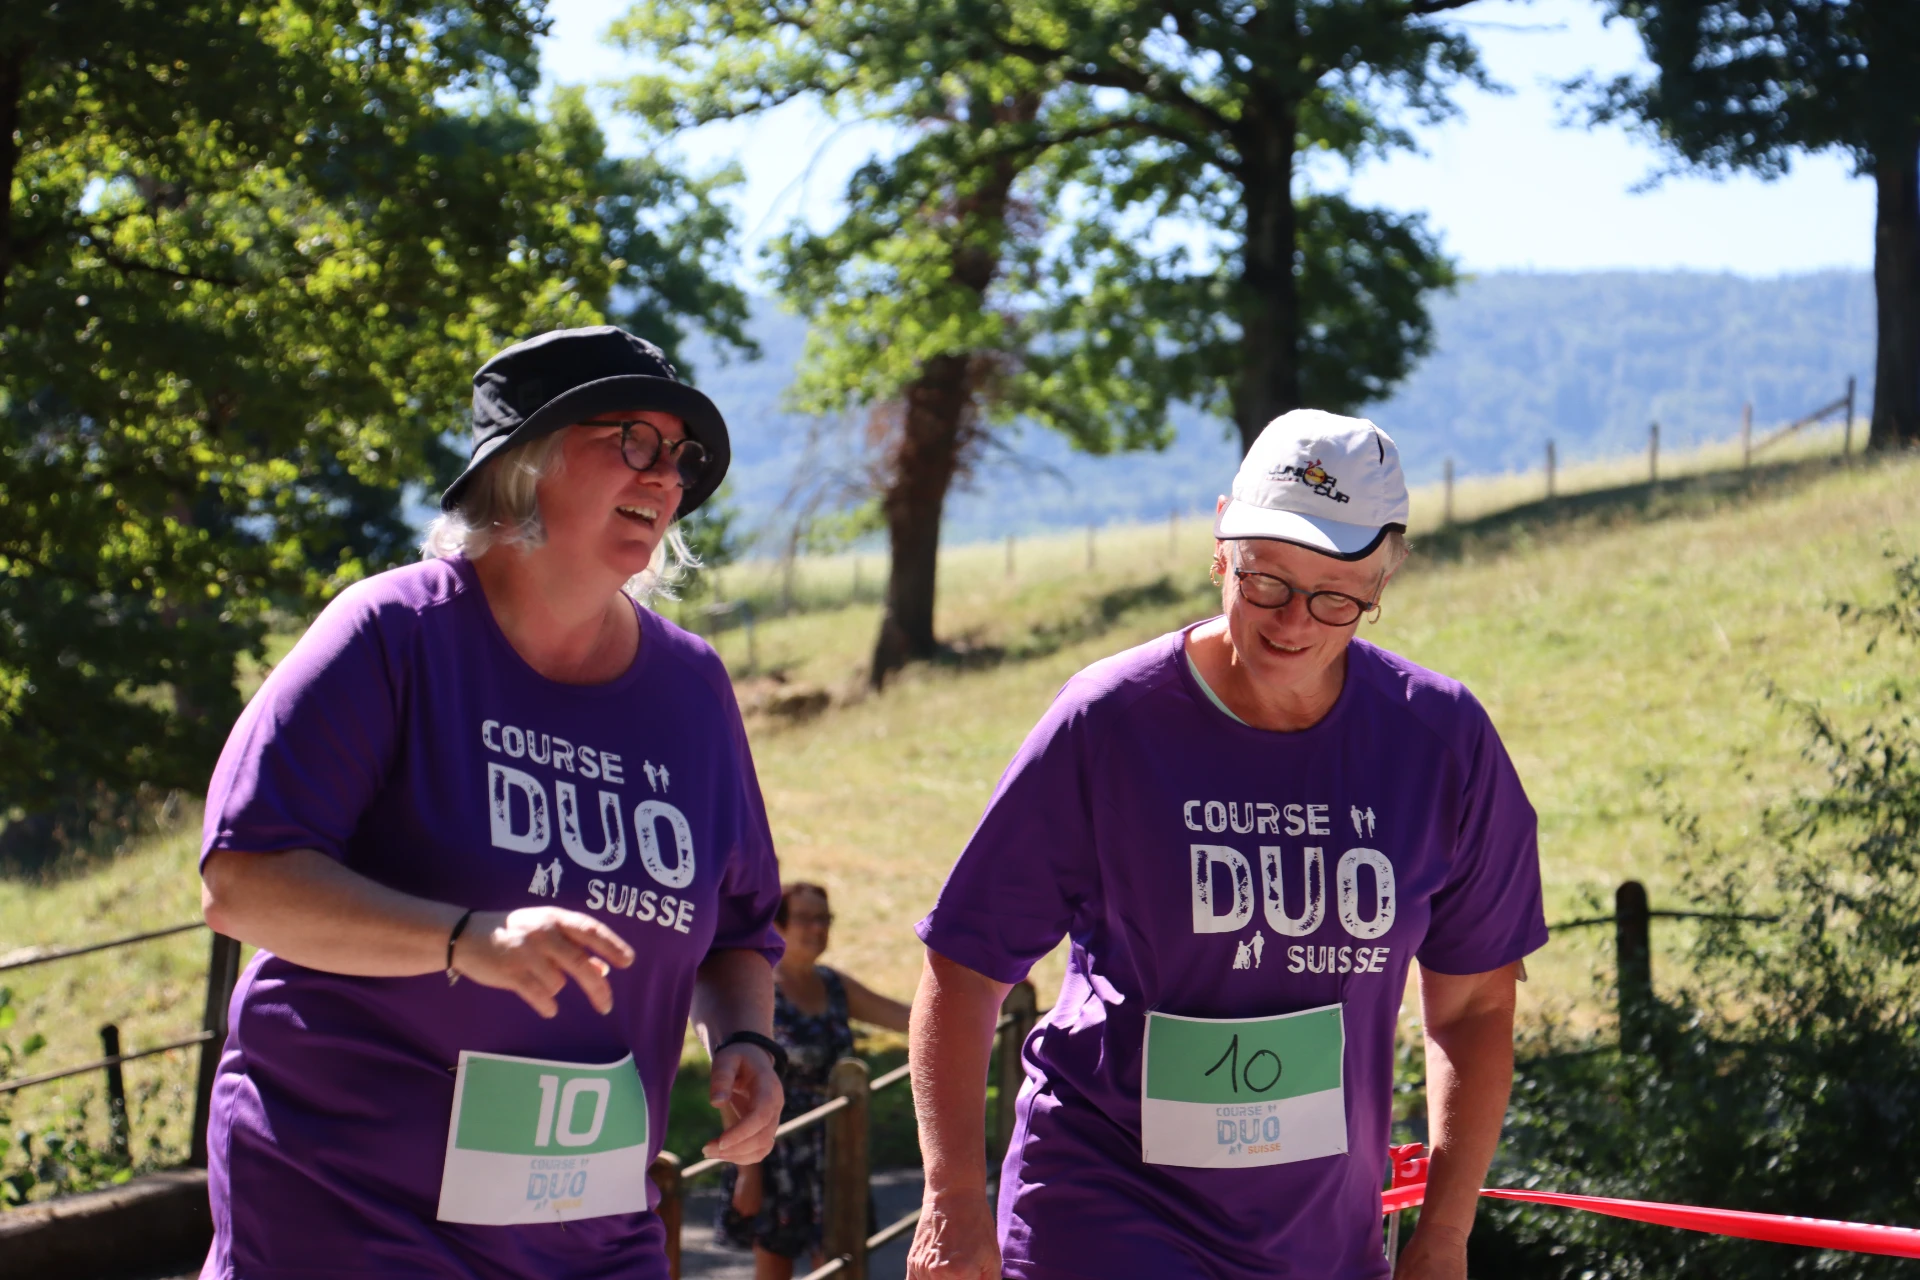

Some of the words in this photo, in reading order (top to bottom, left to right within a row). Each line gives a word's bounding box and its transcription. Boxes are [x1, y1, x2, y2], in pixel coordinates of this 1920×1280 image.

[482, 719, 624, 784] COURSE
[487, 761, 695, 889] DUO
[1183, 800, 1330, 836] COURSE
[585, 879, 695, 934] SUISSE
[1190, 844, 1396, 940] DUO
[1287, 945, 1390, 973] SUISSE
[1204, 1033, 1282, 1093] 10
[534, 1074, 610, 1147] 10
[1215, 1105, 1262, 1117] COURSE
[1217, 1115, 1280, 1145] DUO
[1247, 1142, 1281, 1154] SUISSE
[526, 1170, 587, 1201] DUO
